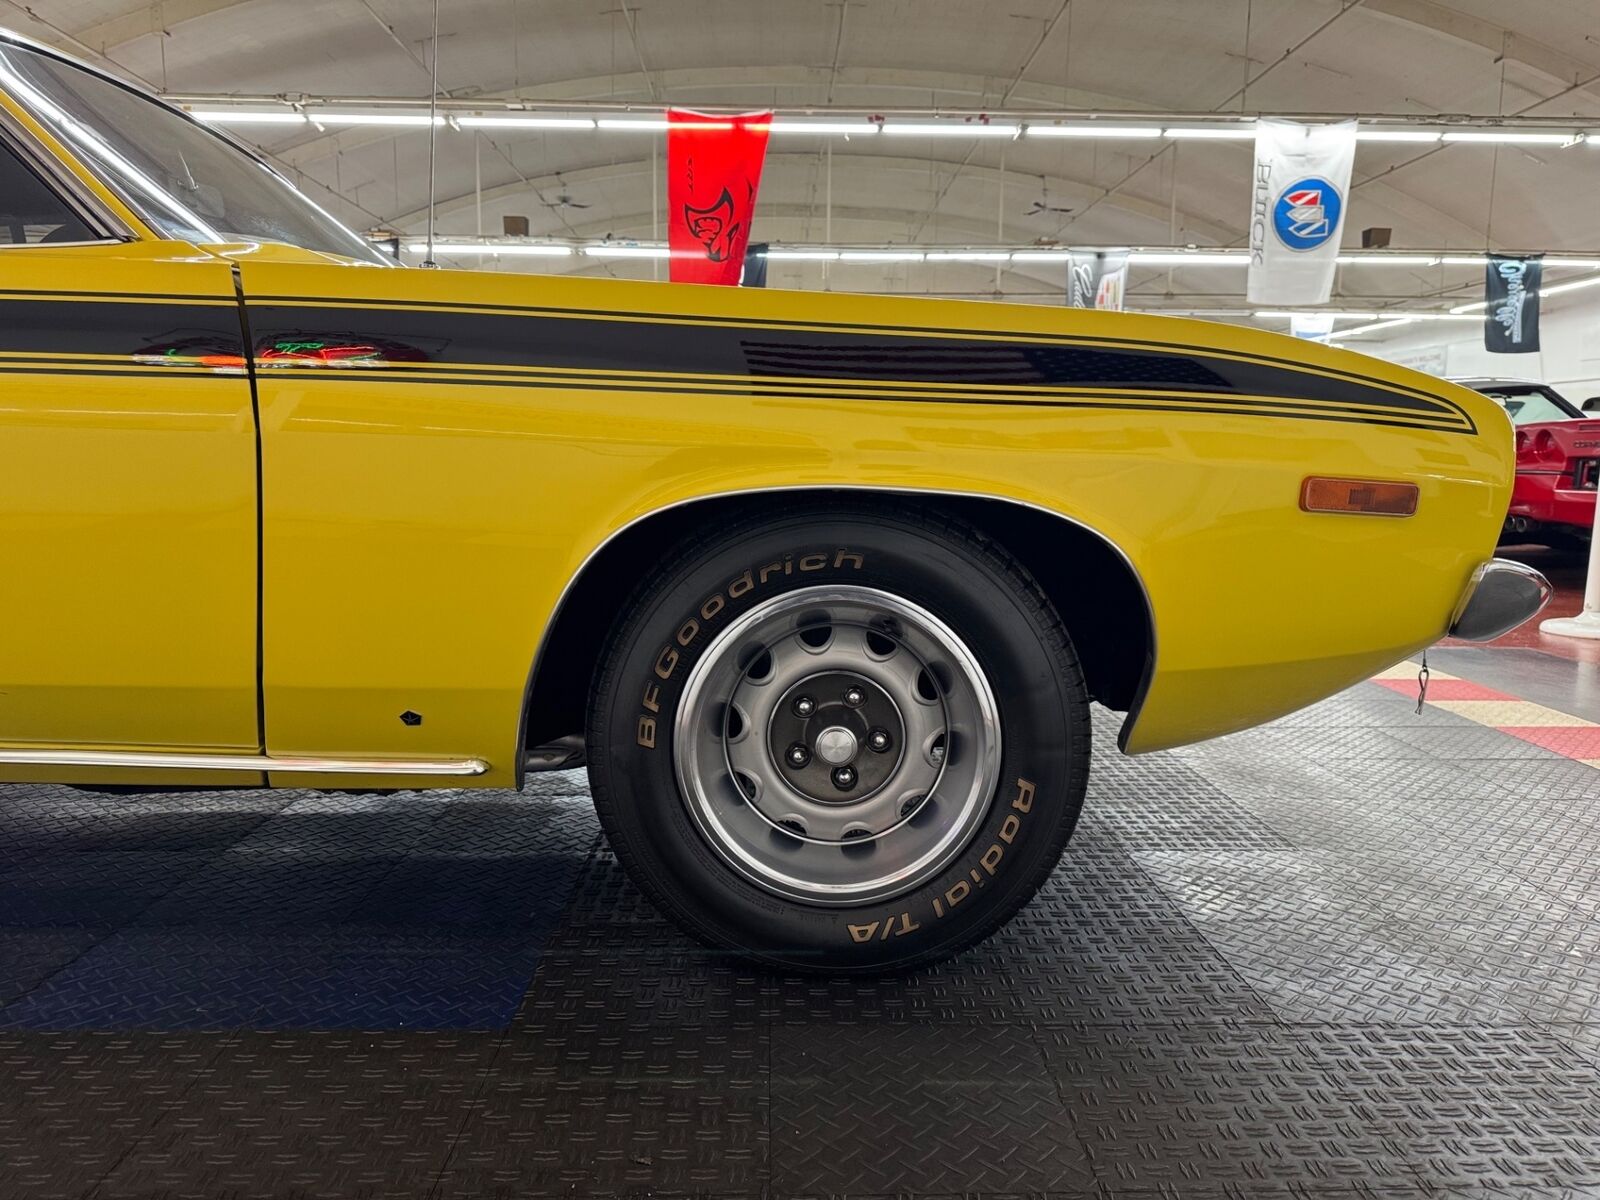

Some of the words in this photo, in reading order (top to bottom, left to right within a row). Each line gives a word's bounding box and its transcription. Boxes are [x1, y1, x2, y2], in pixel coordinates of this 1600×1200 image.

[1252, 159, 1272, 266] BUICK
[636, 548, 864, 749] BFGoodrich
[932, 777, 1036, 919] Radial
[847, 912, 921, 943] T/A
